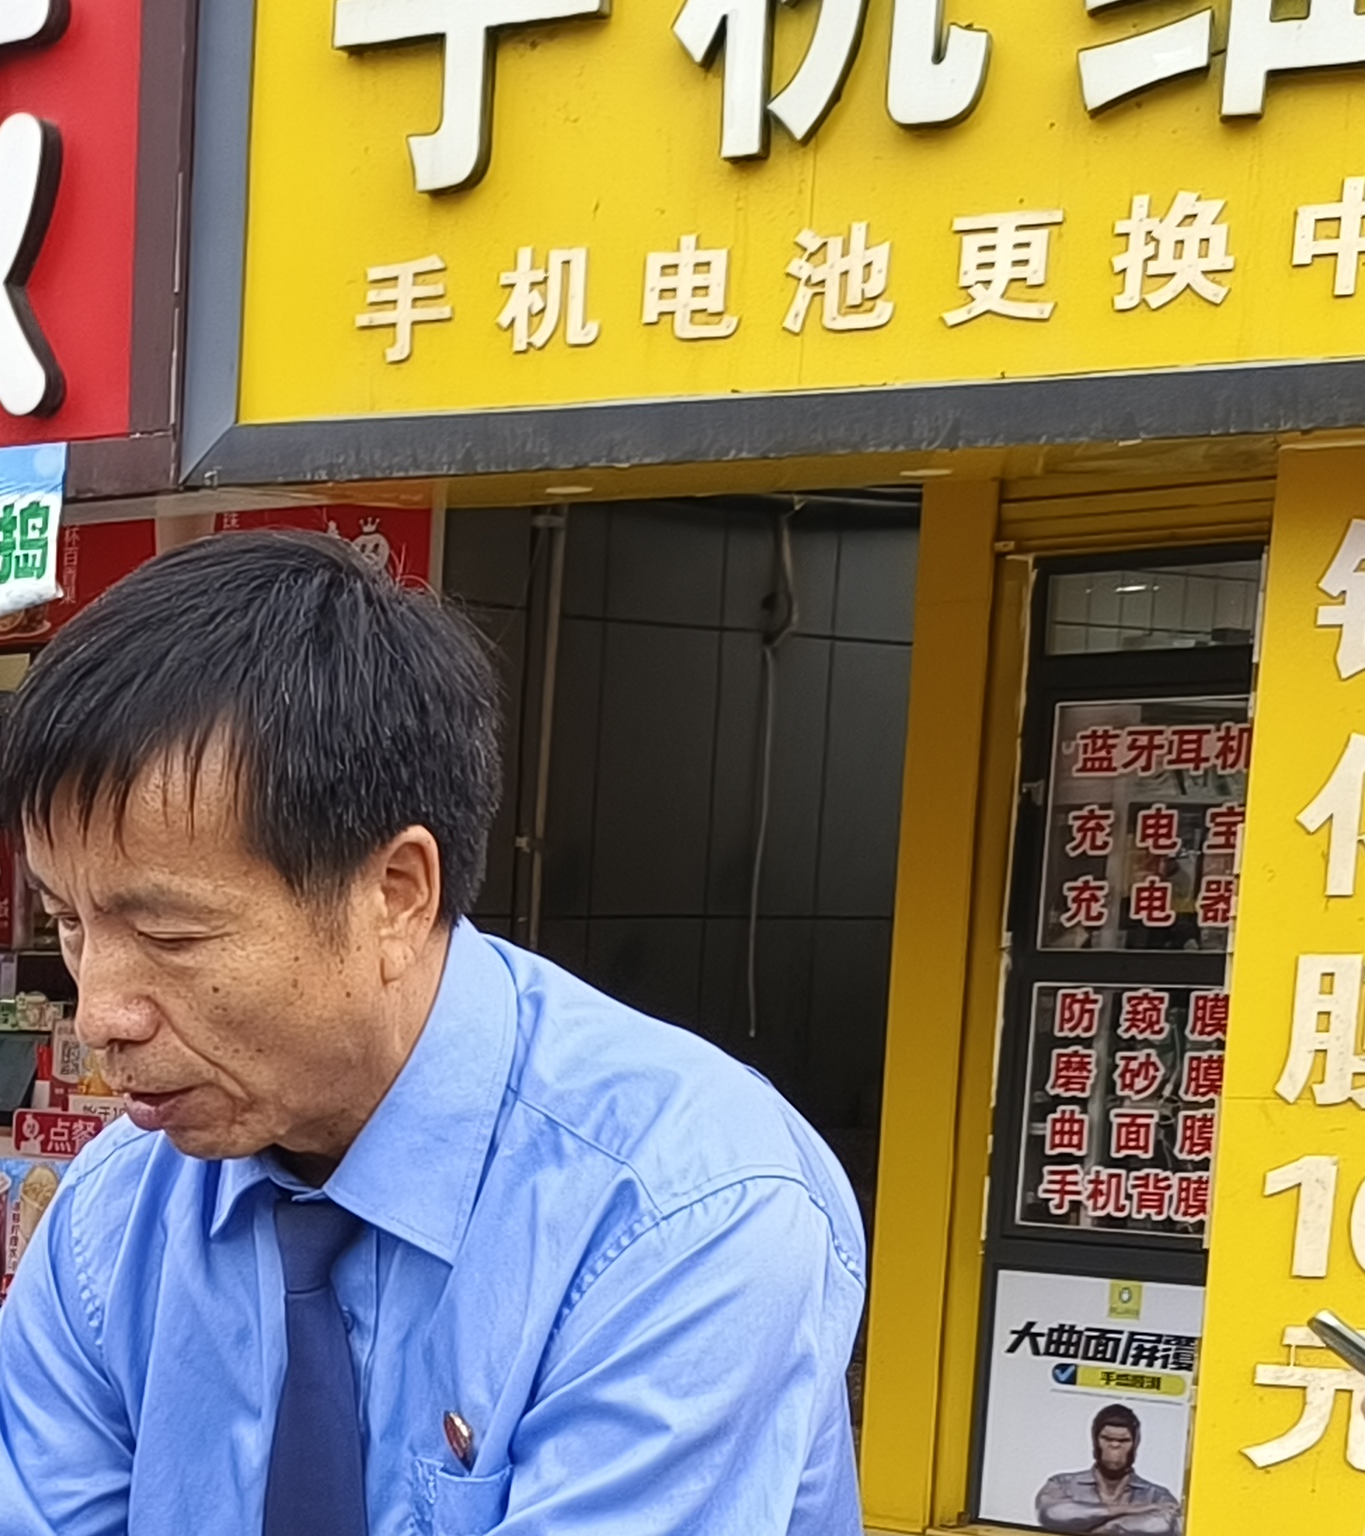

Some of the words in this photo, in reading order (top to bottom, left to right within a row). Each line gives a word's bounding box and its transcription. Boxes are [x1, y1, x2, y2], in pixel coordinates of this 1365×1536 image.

[1074, 726, 1253, 776] 蓝牙耳机
[1066, 804, 1247, 860] 充电宝
[1060, 879, 1237, 929] 充电器
[1054, 989, 1232, 1037] 防窥膜
[1048, 1049, 1225, 1098] 磨砂膜
[1043, 1107, 1218, 1158] 曲面膜
[1038, 1167, 1214, 1220] 手机背膜
